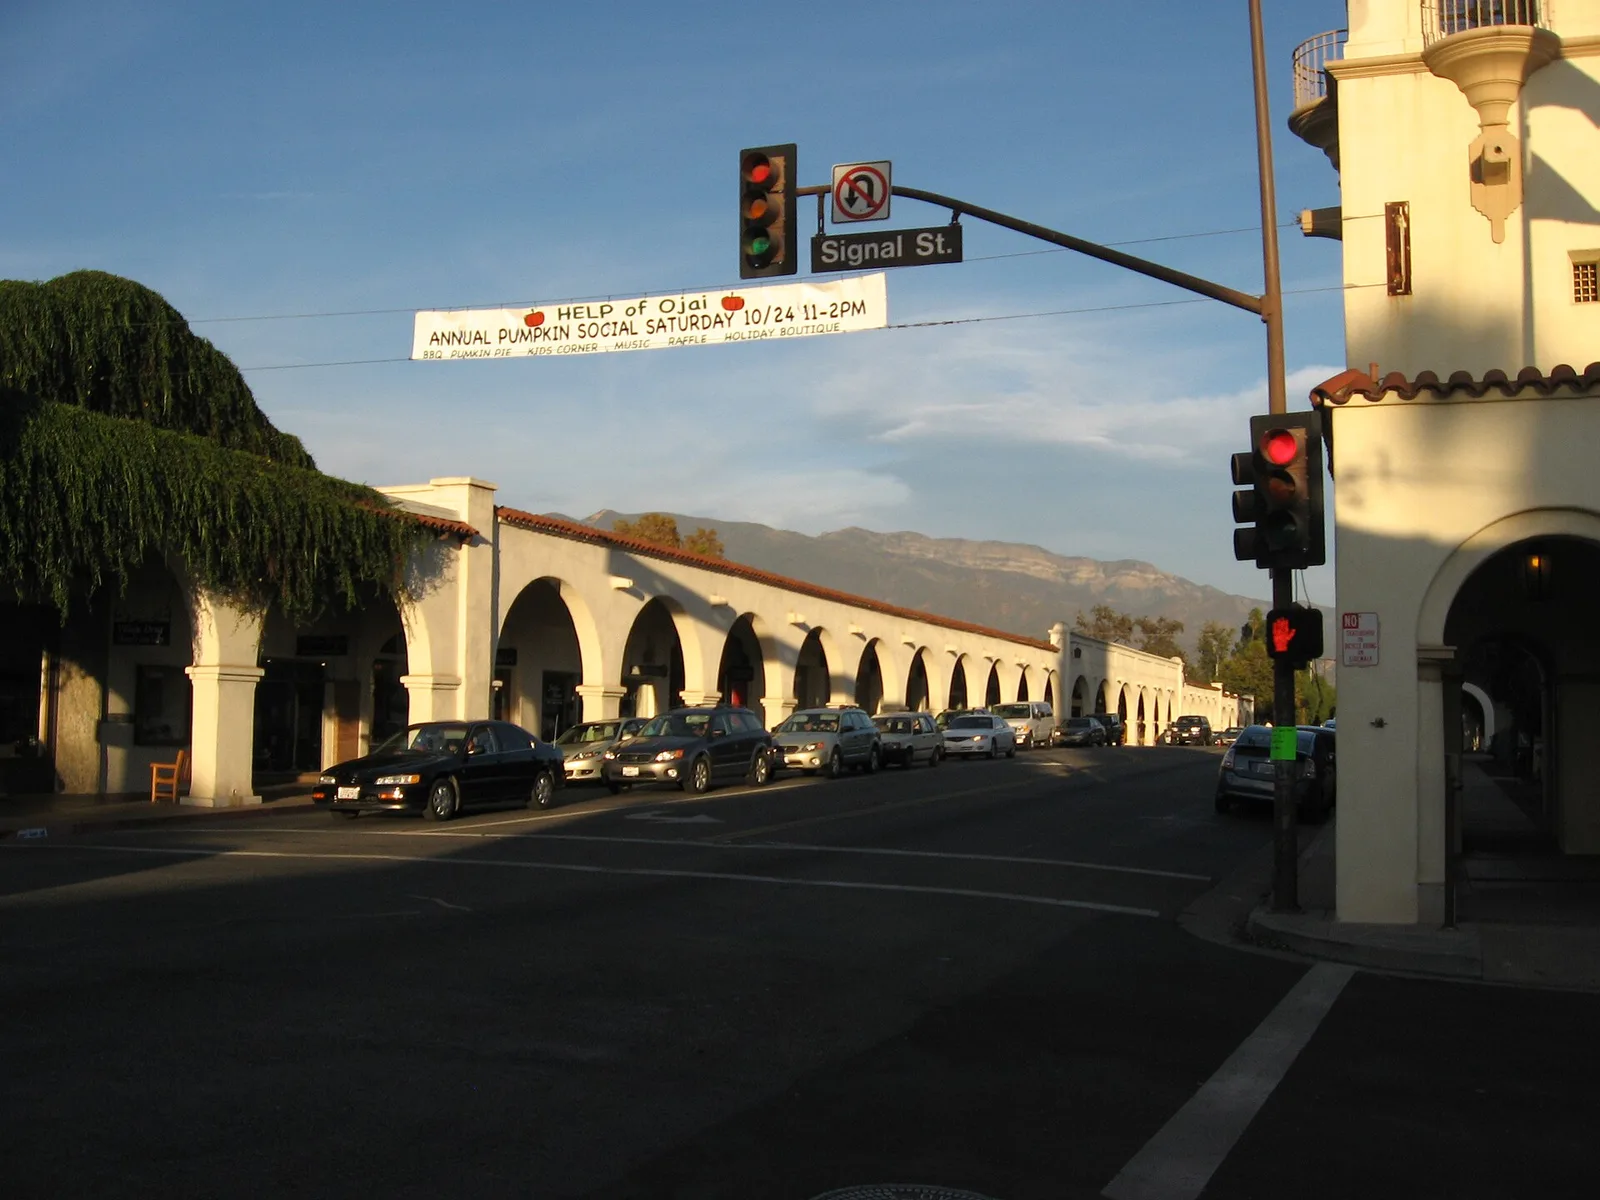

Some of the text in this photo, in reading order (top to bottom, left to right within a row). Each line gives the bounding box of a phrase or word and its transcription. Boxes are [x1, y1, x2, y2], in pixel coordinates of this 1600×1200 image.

[821, 232, 952, 267] Signal St.
[429, 299, 866, 346] ANNUAL PUMPKIN SOCIAL SATURDAY 10/24 11-2PM
[558, 295, 707, 321] HELP of Ojai
[423, 350, 442, 360] BBQ
[495, 347, 512, 357] PIE
[527, 345, 552, 356] KIDS
[557, 342, 598, 354] CORNER
[614, 339, 650, 350] MUSIC
[668, 334, 707, 346] RAFFLE
[725, 329, 775, 342] HOLIDAY
[780, 322, 841, 337] BOUTIQUE
[1344, 615, 1357, 627] NO
